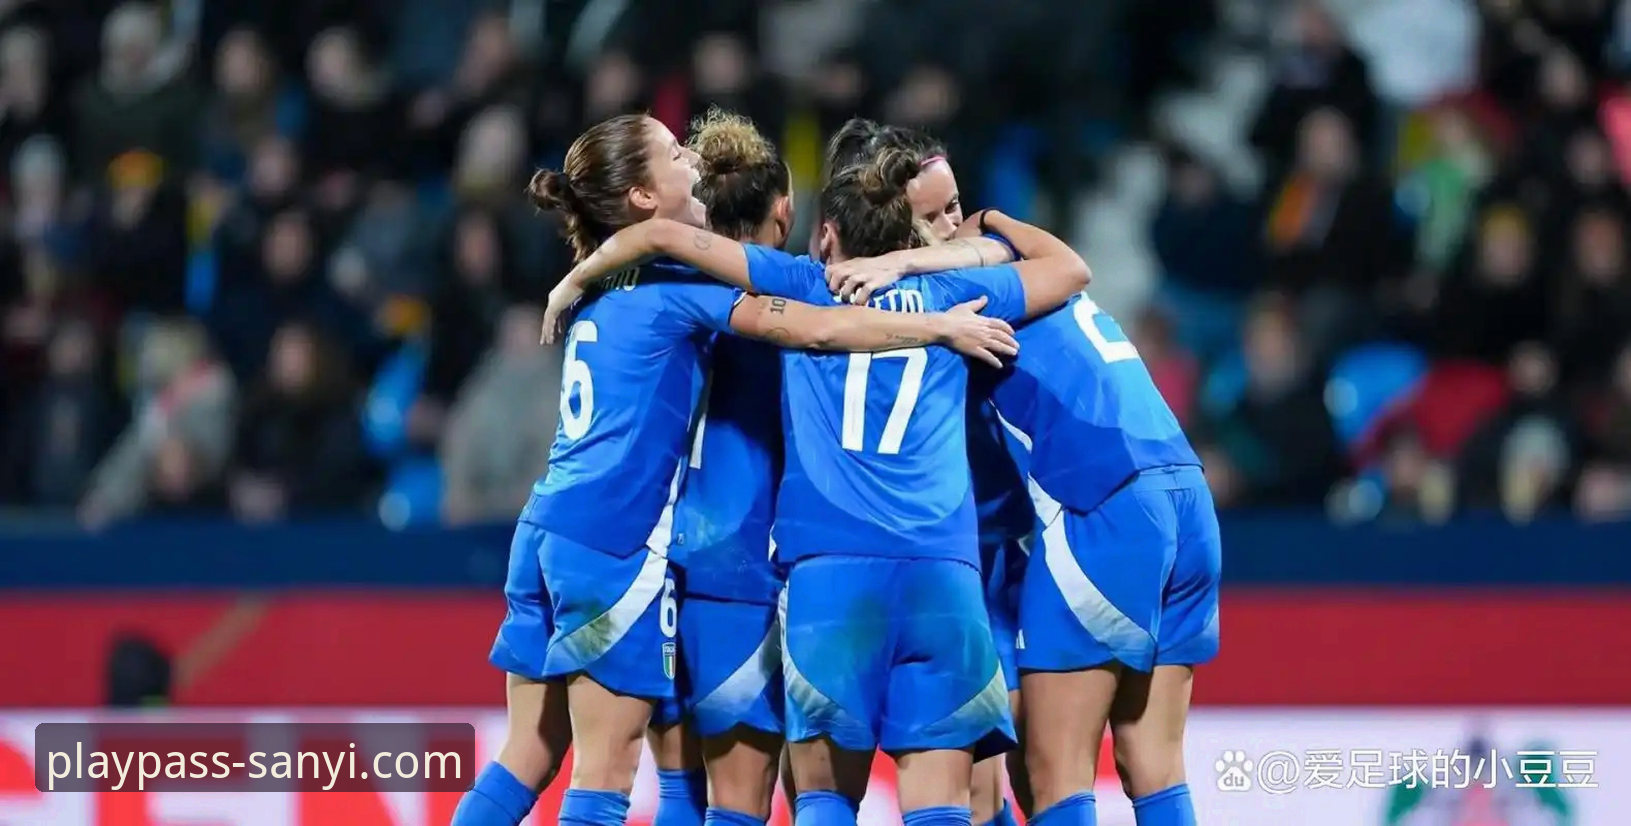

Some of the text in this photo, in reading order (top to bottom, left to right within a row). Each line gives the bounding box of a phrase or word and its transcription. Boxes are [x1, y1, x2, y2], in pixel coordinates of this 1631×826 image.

[560, 320, 598, 440] 6
[842, 347, 928, 454] 17
[660, 578, 677, 638] 6
